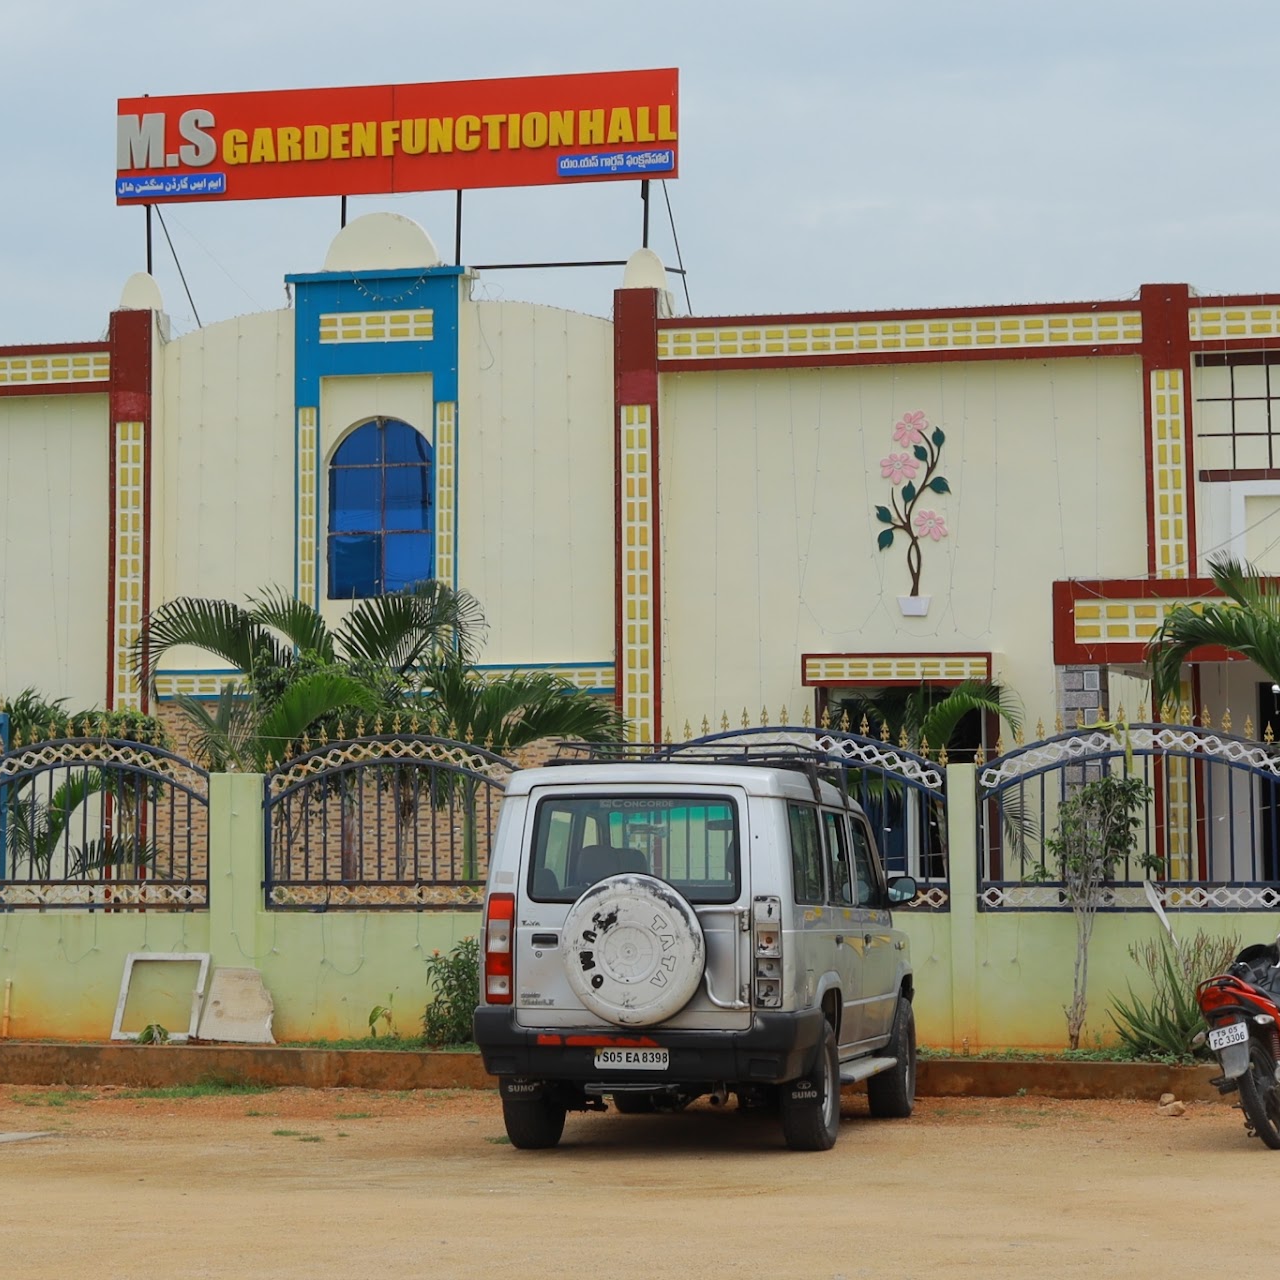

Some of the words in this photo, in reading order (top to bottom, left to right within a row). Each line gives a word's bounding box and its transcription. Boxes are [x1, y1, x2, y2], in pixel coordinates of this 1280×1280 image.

[117, 108, 218, 170] M.S
[222, 121, 377, 165] GARDEN
[380, 110, 575, 157] FUNCTION
[578, 104, 678, 145] HALL
[650, 914, 677, 988] TATA
[1228, 1026, 1238, 1034] 05
[1213, 1037, 1225, 1048] FC
[1226, 1032, 1245, 1043] 3306
[625, 1052, 640, 1063] EA
[642, 1052, 668, 1064] 8398
[508, 1084, 535, 1093] SUMO
[791, 1090, 818, 1100] SUMO
